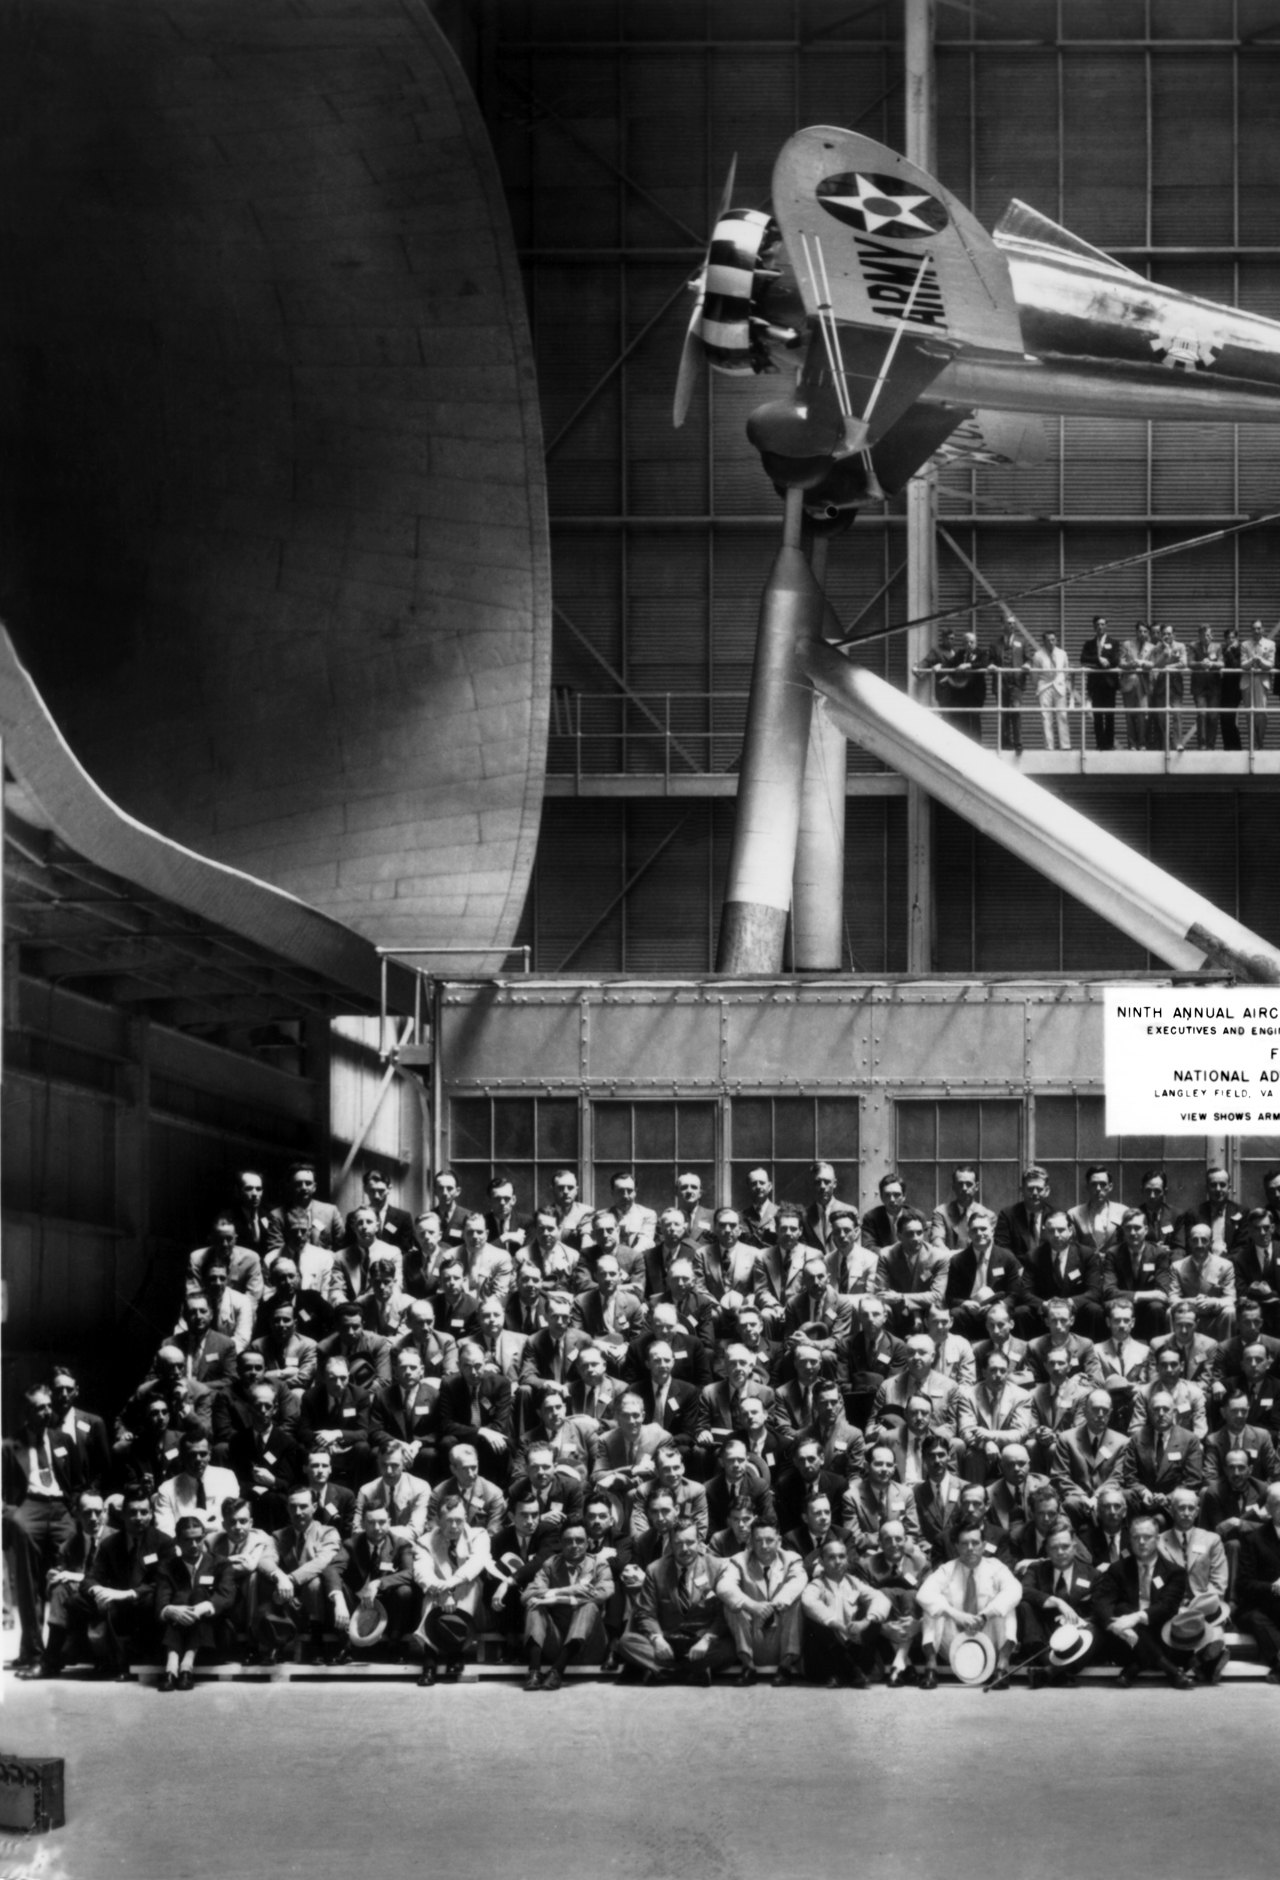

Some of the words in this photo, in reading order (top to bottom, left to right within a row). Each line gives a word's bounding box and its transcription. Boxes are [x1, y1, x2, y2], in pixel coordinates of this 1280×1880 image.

[853, 236, 948, 329] ARMY
[1117, 1006, 1162, 1019] NINTH
[1173, 1007, 1234, 1020] ANNUAL
[1147, 1026, 1217, 1036] EXECUTIVES
[1223, 1026, 1245, 1036] AND
[1174, 1070, 1250, 1083] NATIONAL
[1154, 1089, 1207, 1098] LANGLEY
[1180, 1112, 1208, 1121] VIEW
[1213, 1112, 1252, 1121] SHOWS
